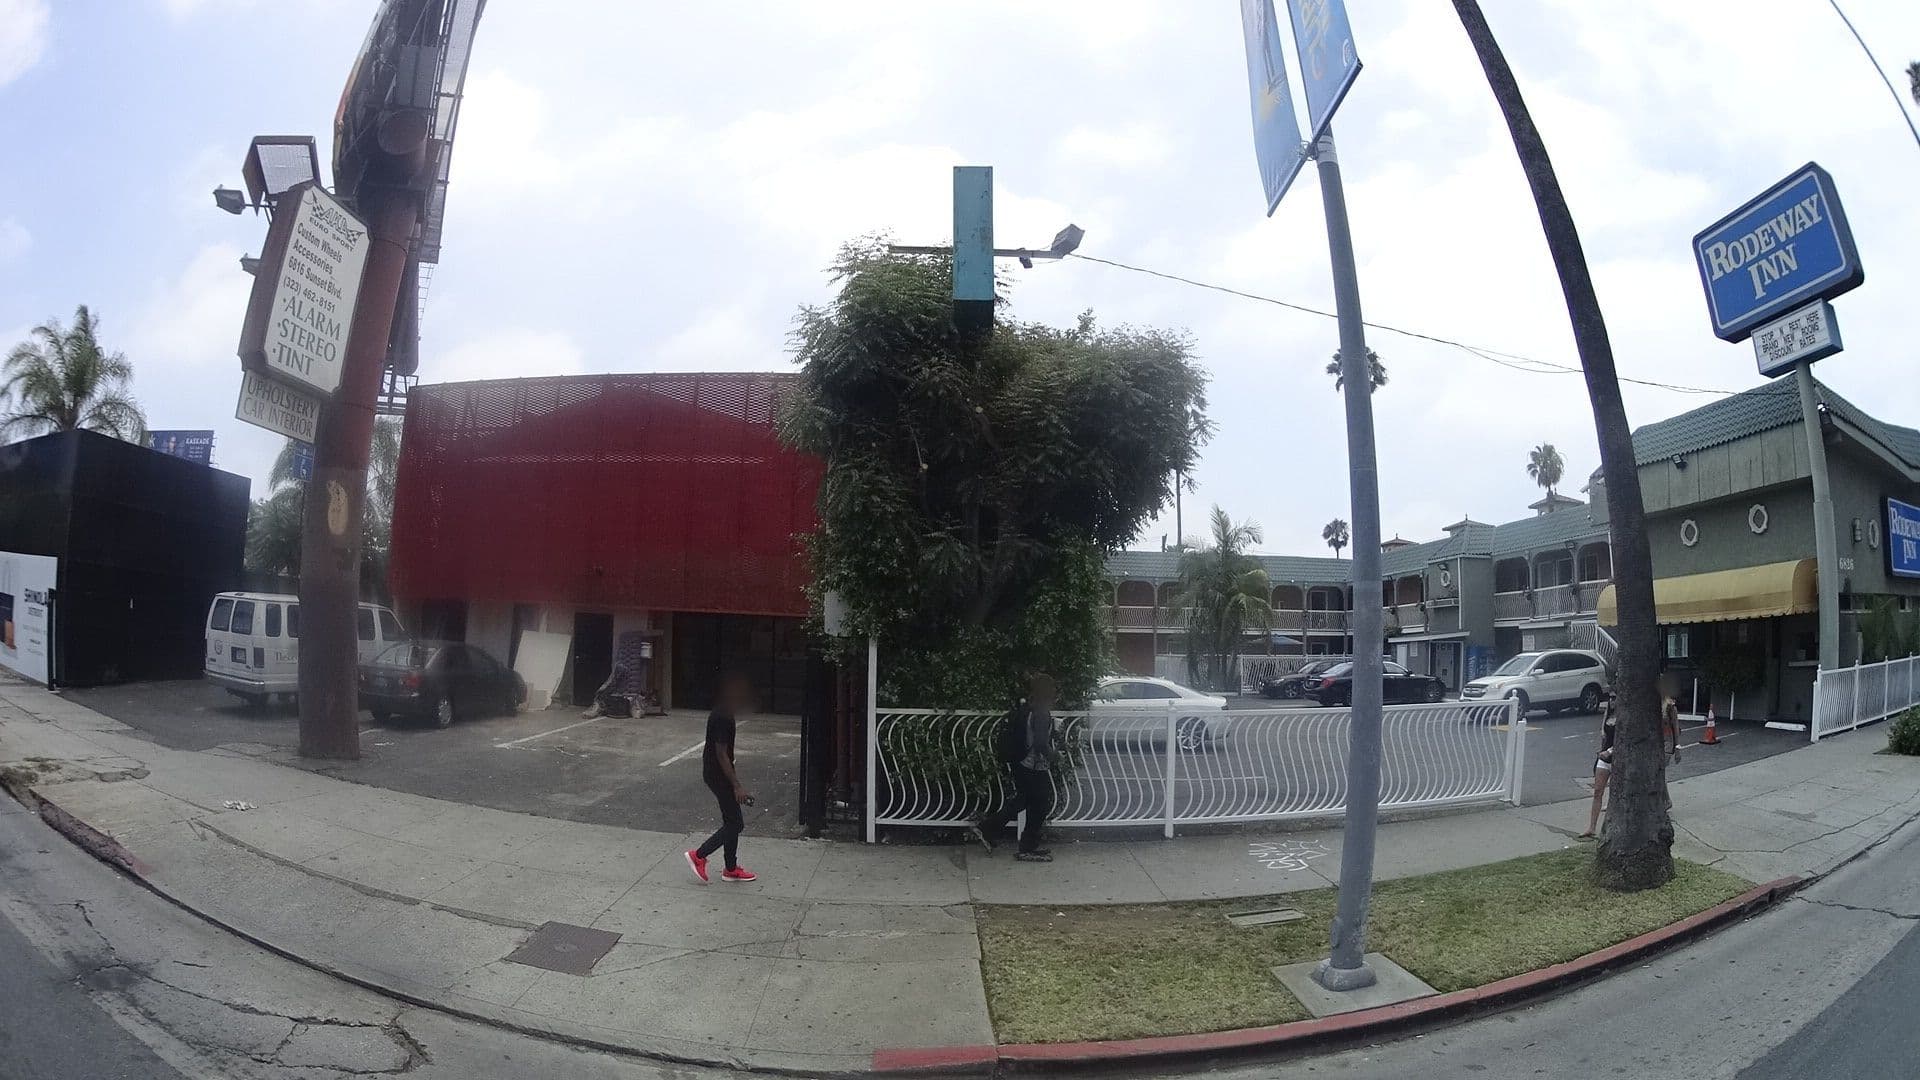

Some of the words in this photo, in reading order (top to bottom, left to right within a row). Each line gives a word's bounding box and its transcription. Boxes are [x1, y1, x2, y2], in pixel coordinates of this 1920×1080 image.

[298, 222, 320, 248] Custom
[321, 239, 342, 263] Wheels
[310, 217, 328, 233] EURO
[332, 233, 354, 251] SPORT
[1705, 193, 1822, 281] RODEWAY
[293, 239, 333, 275] Accessories
[1747, 243, 1798, 300] INN
[283, 275, 301, 296] (323)
[303, 287, 336, 313] 462-8151
[288, 256, 305, 276] 6816
[305, 267, 327, 291] Sunset
[327, 281, 342, 300] Blvd.
[285, 295, 341, 341] ALARM
[1761, 331, 1774, 344] STOP
[1788, 318, 1801, 330] REST
[277, 341, 314, 375] TINT
[280, 318, 336, 362] STEREO
[1762, 339, 1779, 353] BRAND
[1783, 332, 1795, 343] NEW
[1769, 343, 1794, 361] DISCOUNT
[1800, 334, 1816, 349] RATES
[247, 376, 317, 418] UPHOLSTERY
[243, 397, 265, 420] CAR
[269, 405, 313, 437] INTERIOR
[1903, 538, 1917, 564] INN
